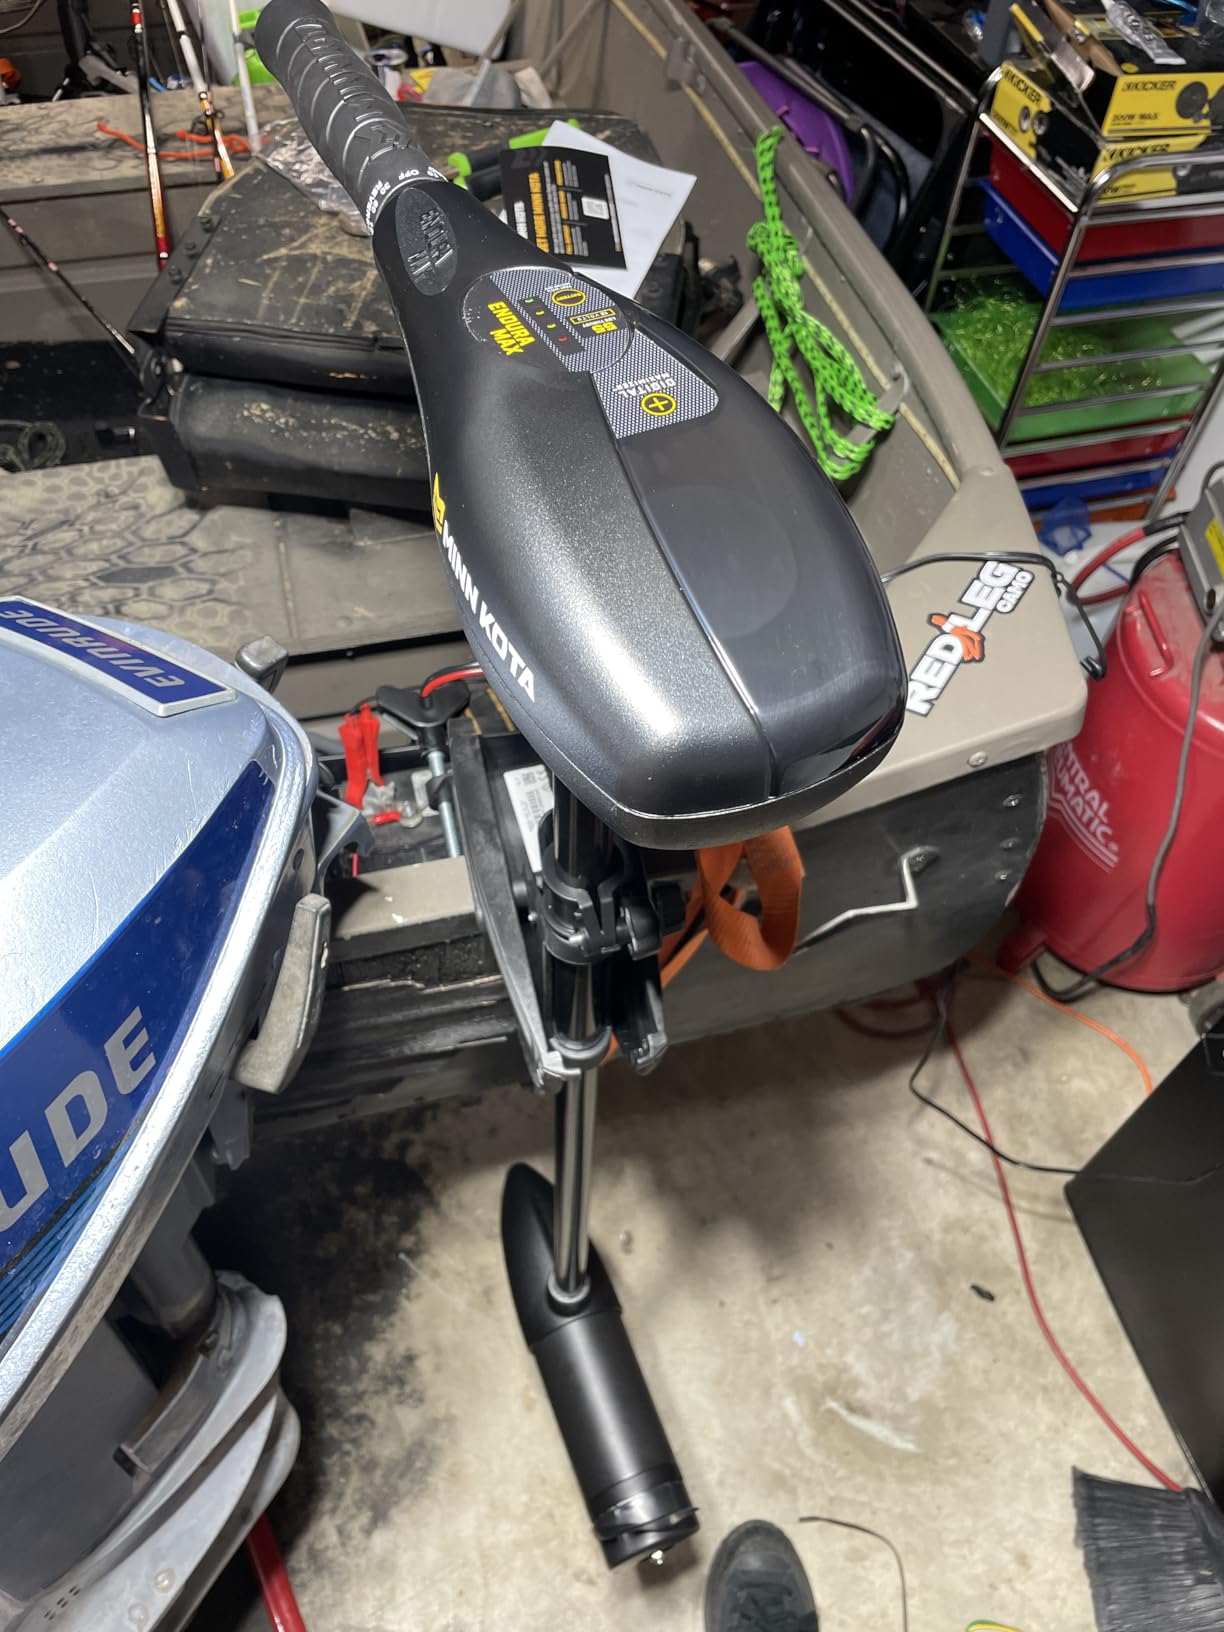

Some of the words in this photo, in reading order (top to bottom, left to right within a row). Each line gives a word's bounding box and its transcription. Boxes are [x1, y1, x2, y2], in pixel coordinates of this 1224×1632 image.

[398, 169, 420, 181] OFF
[487, 300, 536, 347] ENDURA
[591, 321, 618, 334] 55
[489, 328, 525, 356] MAX
[613, 372, 671, 392] MAXIMIZER
[618, 377, 677, 399] DIGITAL
[995, 570, 1034, 613] CAMO
[442, 519, 480, 615] MINN
[479, 600, 535, 703] KOTA
[0, 609, 186, 688] EVINRUDE
[905, 632, 965, 717] RED
[941, 560, 1021, 634] LEG
